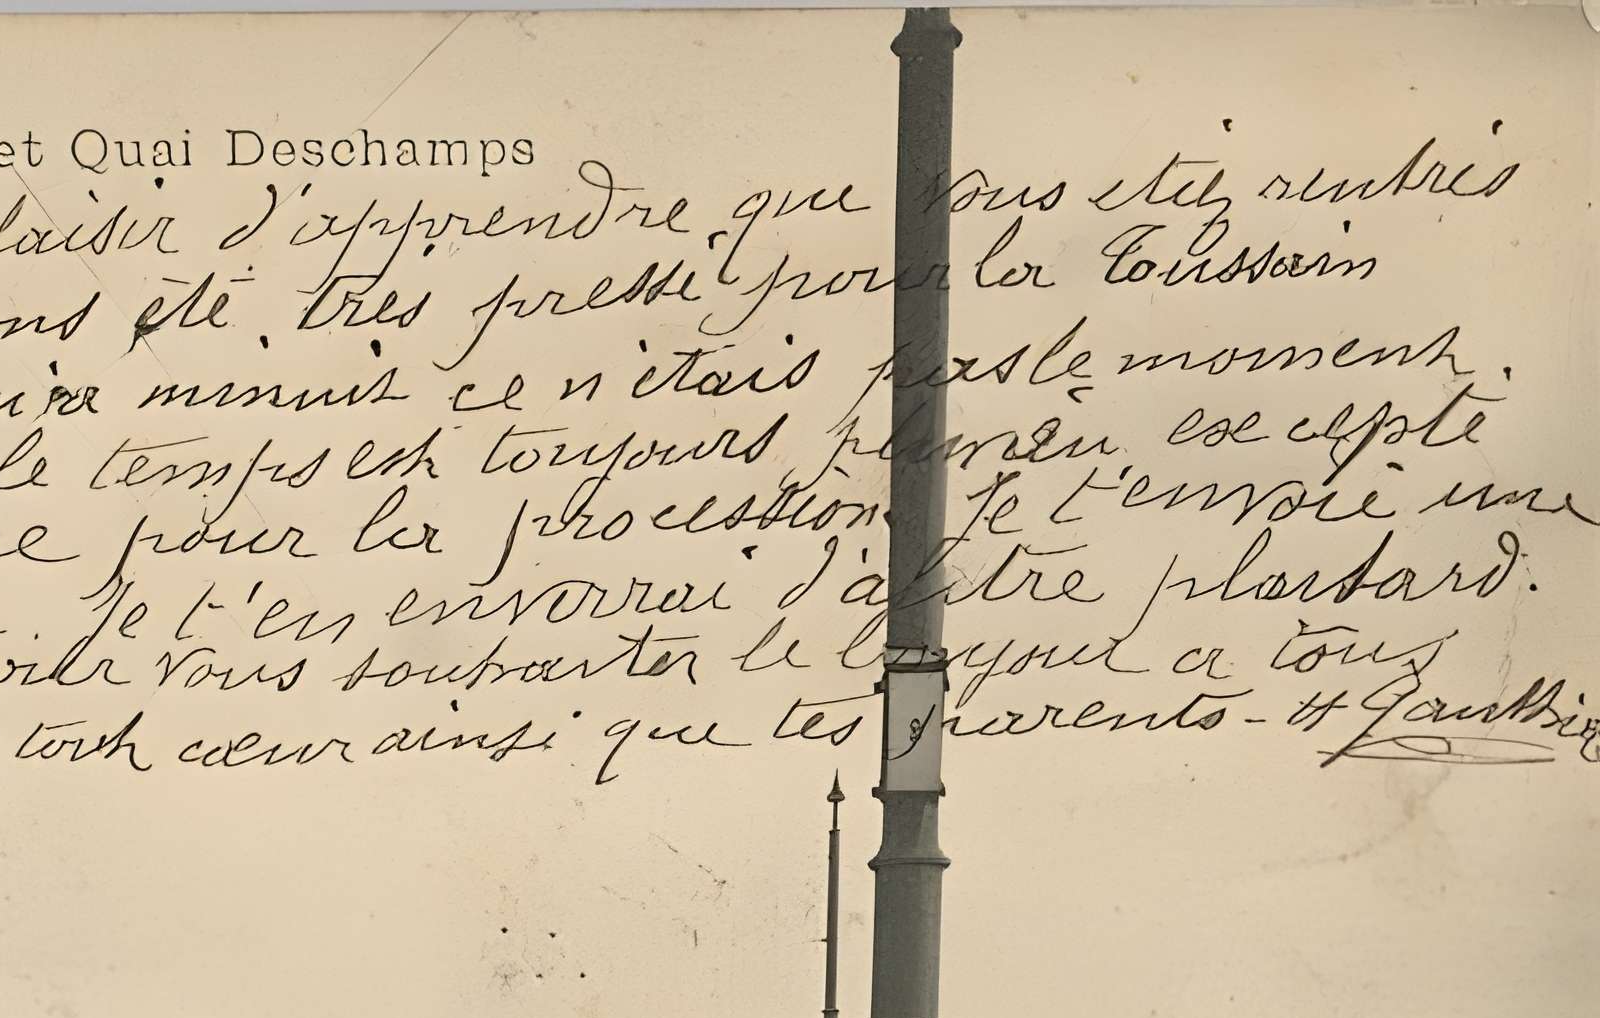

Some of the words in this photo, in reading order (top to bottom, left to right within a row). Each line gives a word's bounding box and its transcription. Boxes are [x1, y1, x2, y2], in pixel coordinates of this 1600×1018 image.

[700, 254, 949, 336] pour
[976, 216, 1056, 288] la
[716, 184, 871, 285] que
[137, 340, 408, 411] minuit
[448, 373, 522, 411] ce
[1029, 316, 1093, 385] le
[88, 436, 330, 524] temps
[347, 427, 440, 478] est
[481, 414, 788, 500] toujours
[90, 516, 318, 592] pour
[354, 486, 443, 553] la
[1418, 481, 1600, 526] une
[733, 617, 811, 672] le
[1270, 619, 1458, 678] tous
[15, 712, 150, 771] tout
[595, 718, 751, 785] que
[771, 692, 885, 746] tes
